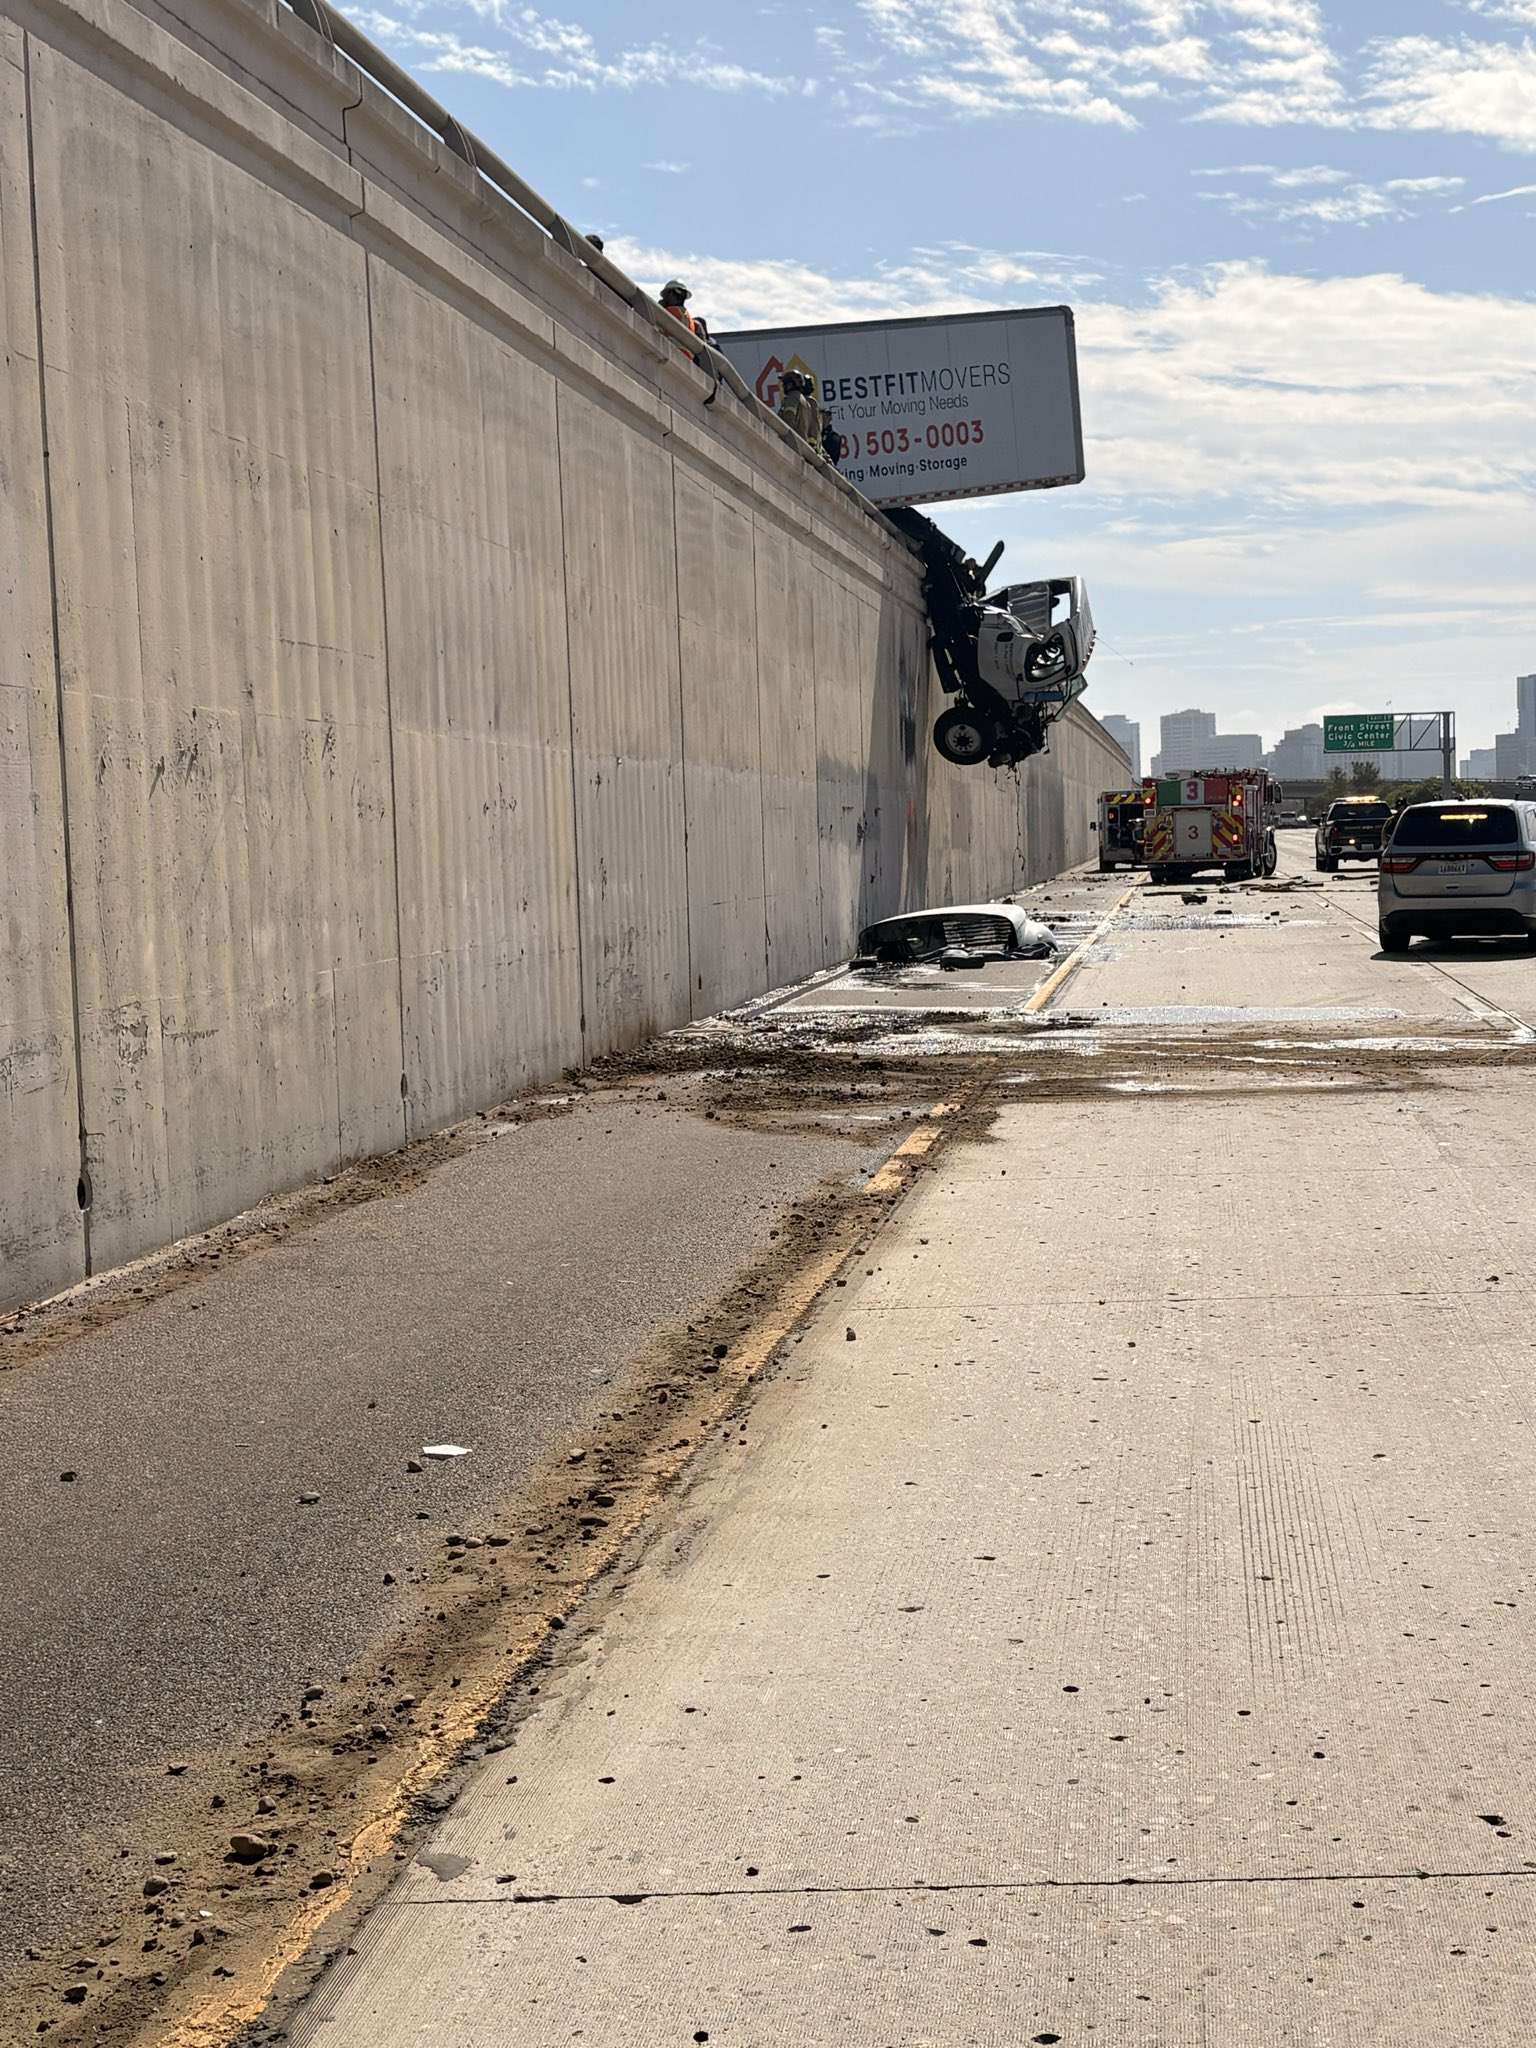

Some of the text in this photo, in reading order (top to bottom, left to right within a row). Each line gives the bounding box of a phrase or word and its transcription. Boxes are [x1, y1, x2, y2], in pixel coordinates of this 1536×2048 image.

[822, 363, 1011, 402] BESTFITMOVERS
[848, 403, 877, 418] Your
[880, 400, 926, 416] Moving
[929, 394, 969, 411] Needs
[866, 419, 984, 456] 503-0003
[919, 456, 968, 472] Storage
[1327, 723, 1391, 732] Front Street
[1328, 732, 1390, 741] Civic Center
[1186, 781, 1199, 801] 3
[1187, 825, 1199, 840] 3
